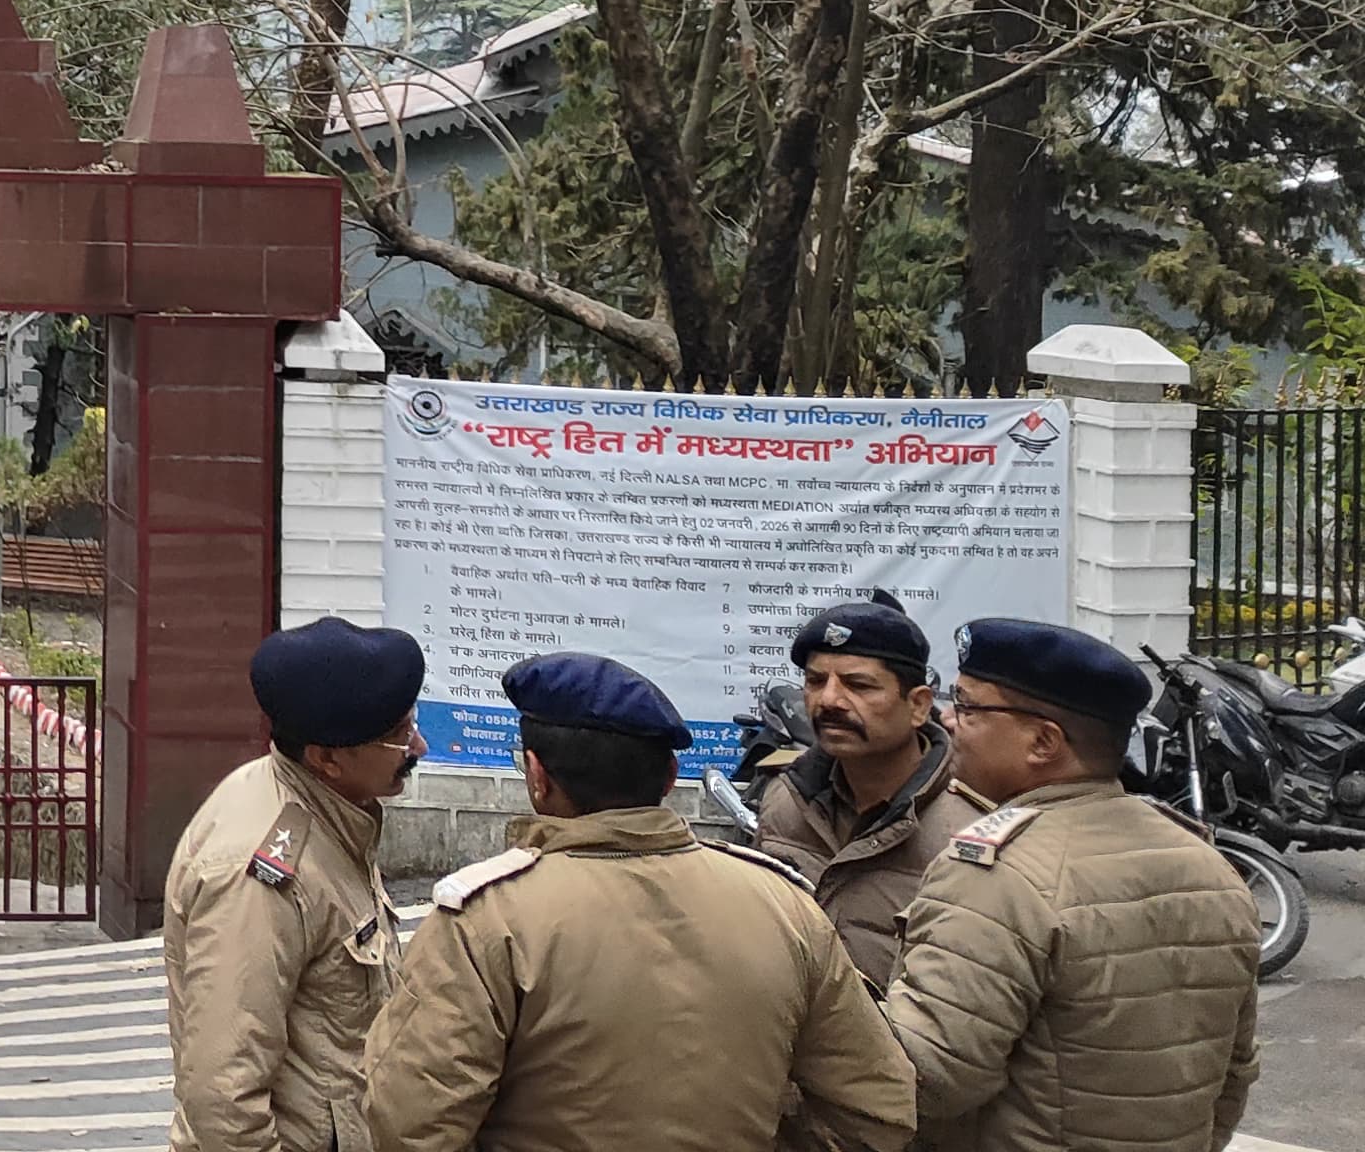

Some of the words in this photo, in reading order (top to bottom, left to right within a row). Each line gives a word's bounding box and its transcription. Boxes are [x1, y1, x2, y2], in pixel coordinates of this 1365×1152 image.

[475, 394, 584, 416] उत्तराखण्ड
[591, 399, 645, 418] राज्य
[653, 398, 726, 421] विधिक
[733, 403, 777, 424] सेवा
[784, 405, 893, 429] प्राधिकरण,
[900, 406, 990, 430] नैनीताल
[561, 420, 628, 455] हित
[635, 425, 674, 456] में
[865, 434, 998, 467] अभियान
[396, 454, 437, 472] माननीय
[441, 458, 474, 478] राष्ट्रीय
[478, 460, 511, 476] विधिक
[516, 462, 537, 478] सेवा
[600, 468, 616, 483] नई
[620, 469, 653, 485] दिल्ली
[655, 473, 700, 486] NALSA
[704, 476, 725, 487] तथा
[835, 481, 880, 494] न्यायालय
[884, 479, 895, 494] के
[935, 481, 944, 495] के
[949, 484, 994, 499] अनुपालन
[1050, 482, 1061, 496] के
[396, 479, 428, 493] समस्त
[499, 485, 561, 503] निम्नलिखित
[565, 492, 594, 504] प्रकार
[598, 490, 609, 504] के
[613, 490, 647, 507] लम्बित
[692, 495, 706, 510] को
[710, 499, 759, 513] मध्यस्थता
[761, 501, 834, 514] MEDIATION
[915, 506, 950, 518] मध्यस्थ
[953, 504, 997, 519] अधिवक्ता
[1001, 504, 1010, 519] के
[1014, 504, 1048, 519] सहयोग
[1051, 505, 1060, 520] से
[395, 496, 430, 514] आपसी
[513, 505, 524, 520] के
[527, 510, 559, 522] आधार
[562, 512, 576, 523] पर
[579, 509, 626, 526] निस्तारित
[630, 512, 653, 529] किये
[657, 515, 678, 530] जाने
[682, 516, 698, 534] हेतु
[700, 519, 714, 531] 02
[761, 522, 790, 534] 2026
[792, 520, 802, 535] से
[805, 520, 840, 536] आगामी
[843, 524, 856, 536] 90
[885, 522, 895, 537] के
[898, 523, 919, 538] लिए
[922, 523, 969, 542] राष्ट्रव्यापी
[972, 524, 1011, 539] अभियान
[1014, 528, 1044, 540] चलाया
[1046, 529, 1059, 540] जा
[394, 520, 411, 532] रहा
[431, 519, 453, 535] कोई
[456, 520, 469, 536] भी
[472, 522, 494, 538] ऐसा
[498, 524, 525, 540] व्यक्ति
[575, 531, 630, 545] उत्तराखण्ड
[635, 534, 659, 546] राज्य
[662, 532, 673, 547] के
[677, 533, 704, 549] किसी
[708, 535, 721, 550] भी
[724, 539, 771, 553] न्यायालय
[786, 538, 842, 554] अधोलिखित
[845, 540, 875, 558] प्रकृति
[878, 544, 892, 556] का
[896, 541, 917, 557] कोई
[920, 546, 959, 562] मुकदमा
[963, 545, 994, 560] लम्बित
[998, 545, 1004, 560] है
[1007, 545, 1018, 560] तो
[1020, 549, 1034, 560] वह
[1036, 546, 1059, 560] अपने
[394, 538, 428, 553] प्रकरण
[432, 539, 446, 554] को
[449, 544, 498, 559] मध्यस्थता
[501, 545, 511, 560] के
[514, 549, 547, 562] माध्यम
[550, 548, 561, 563] से
[563, 548, 603, 565] निपटाने
[606, 550, 616, 565] के
[620, 551, 641, 566] लिए
[644, 552, 691, 570] सम्बन्धित
[694, 559, 739, 572] न्यायालय
[742, 557, 753, 572] से
[754, 558, 787, 573] सम्पर्क
[789, 562, 805, 574] कर
[808, 563, 838, 575] सकता
[451, 584, 461, 597] के
[590, 576, 601, 586] के
[605, 578, 627, 588] मध्य
[676, 577, 706, 592] विवाद
[749, 584, 793, 596] फौजदारी
[798, 585, 808, 596] के
[812, 585, 851, 597] शमनीय
[450, 603, 477, 618] मोटर
[482, 608, 519, 623] दुर्घटना
[524, 612, 569, 627] मुआवजा
[574, 613, 585, 625] के
[449, 625, 479, 642] घरेलू
[509, 629, 519, 641] के
[749, 625, 771, 636] ऋण
[478, 649, 525, 662] अनादरण
[749, 663, 789, 677] बेदखली
